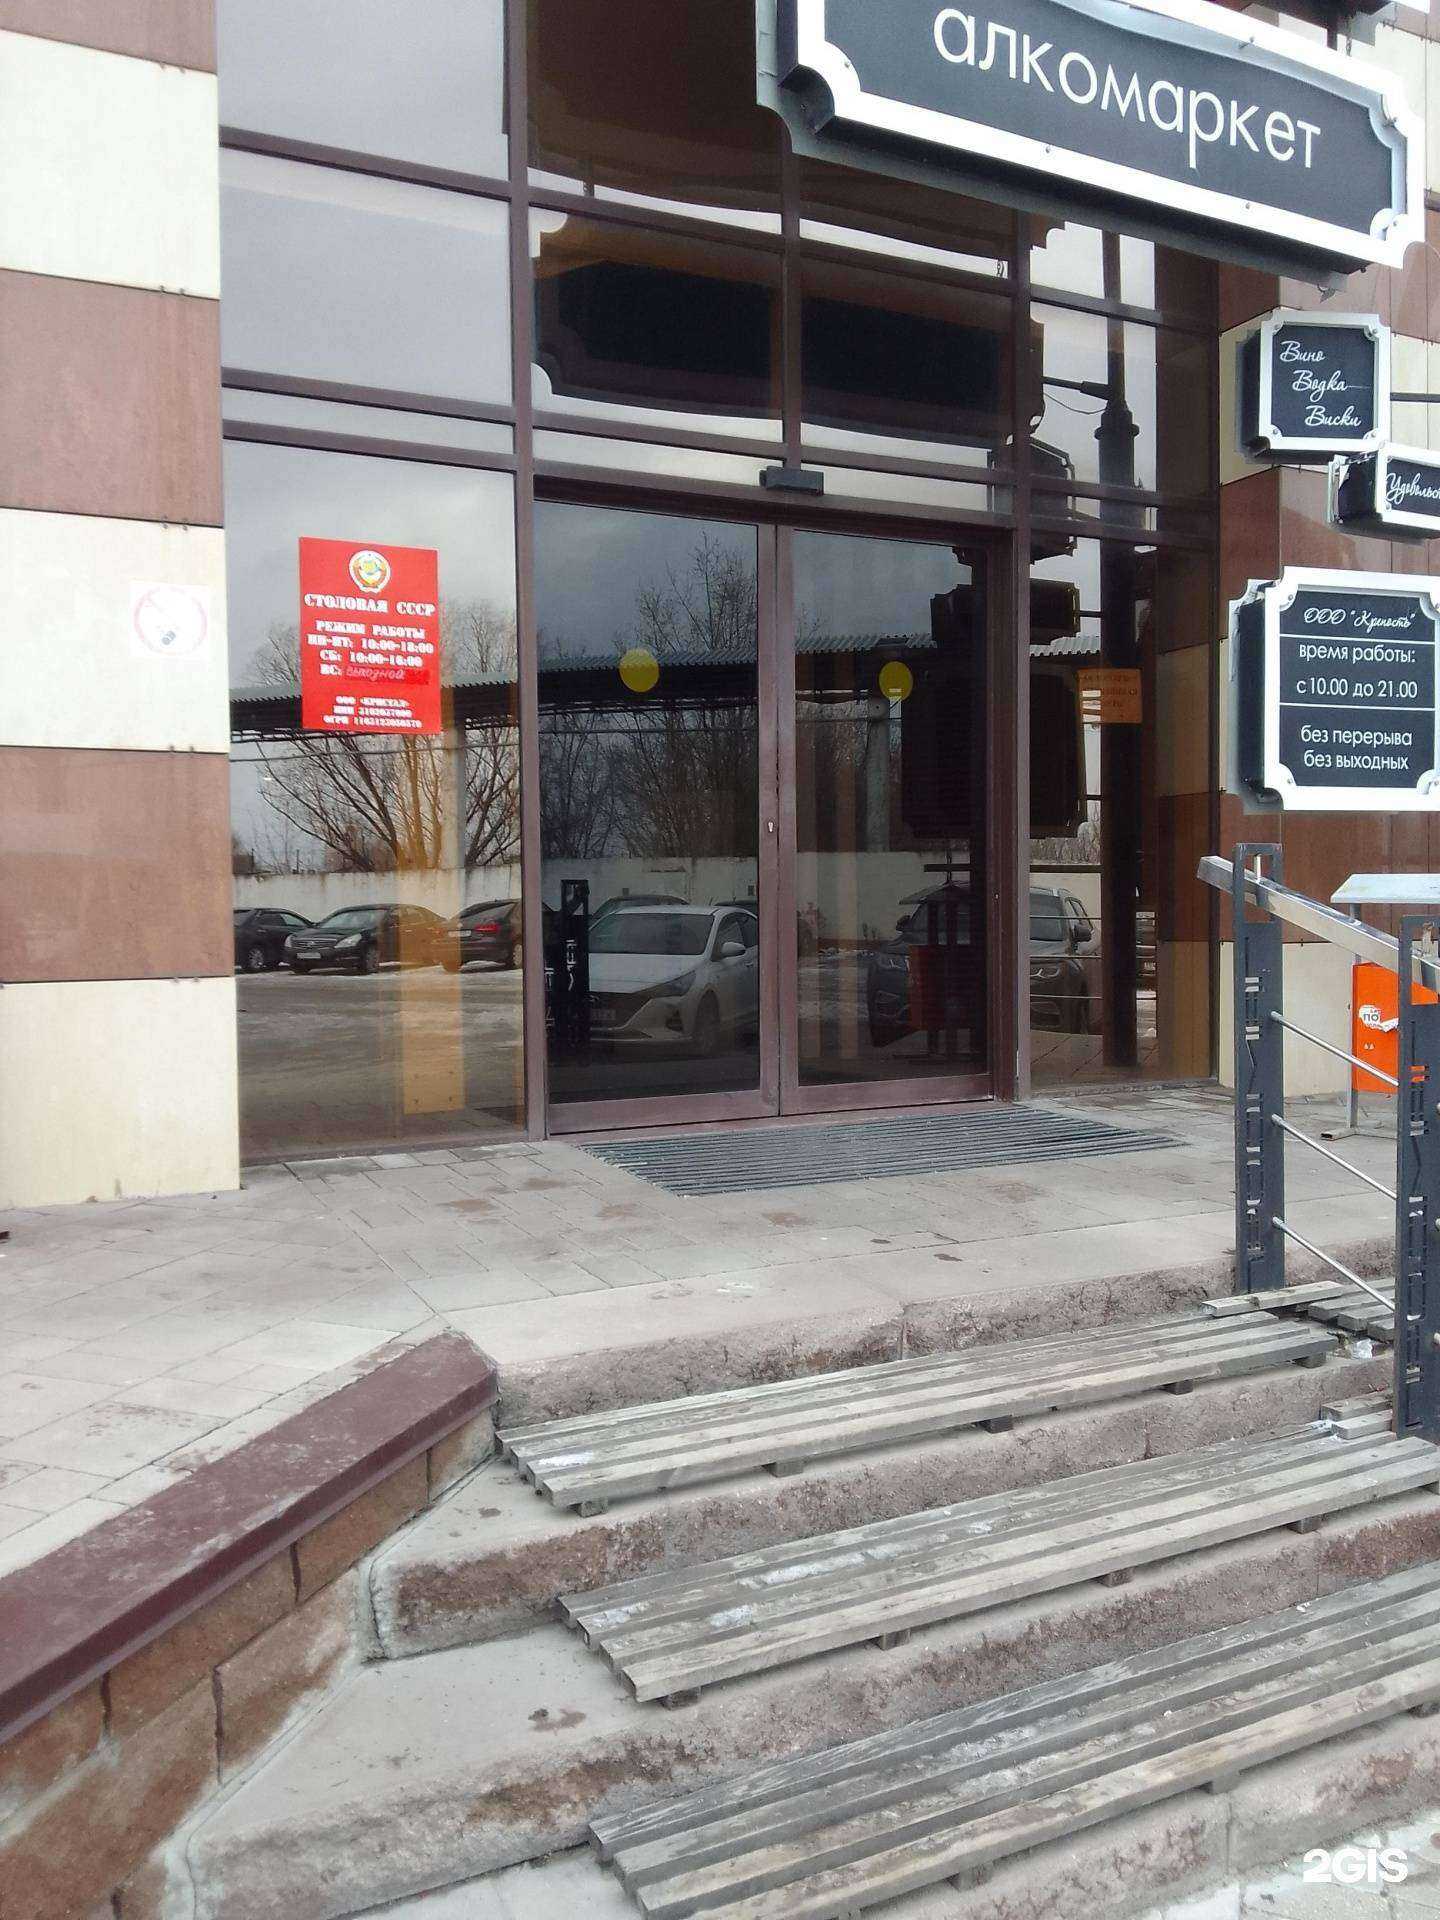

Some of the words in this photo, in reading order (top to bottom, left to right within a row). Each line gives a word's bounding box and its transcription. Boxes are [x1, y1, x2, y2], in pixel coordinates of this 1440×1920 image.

[933, 8, 1321, 169] алкомаркет
[1279, 340, 1326, 362] Вино
[1292, 369, 1348, 402] Водка
[1305, 405, 1361, 427] Виски
[304, 593, 388, 613] СТОЛОВАЯ
[396, 601, 436, 617] СССР
[1304, 607, 1346, 625] ООО
[315, 620, 366, 635] РЕЖИМ
[372, 624, 426, 640] РАБОТЫ
[1299, 644, 1349, 662] время
[1352, 644, 1416, 664] работы:
[1296, 680, 1307, 694] с
[1310, 677, 1349, 696] 10.00
[1352, 682, 1374, 698] до
[1378, 680, 1418, 698] 21.00
[1301, 724, 1329, 743] без
[1333, 729, 1413, 748] перерыва
[1304, 749, 1332, 768] без
[1336, 755, 1409, 771] выходных
